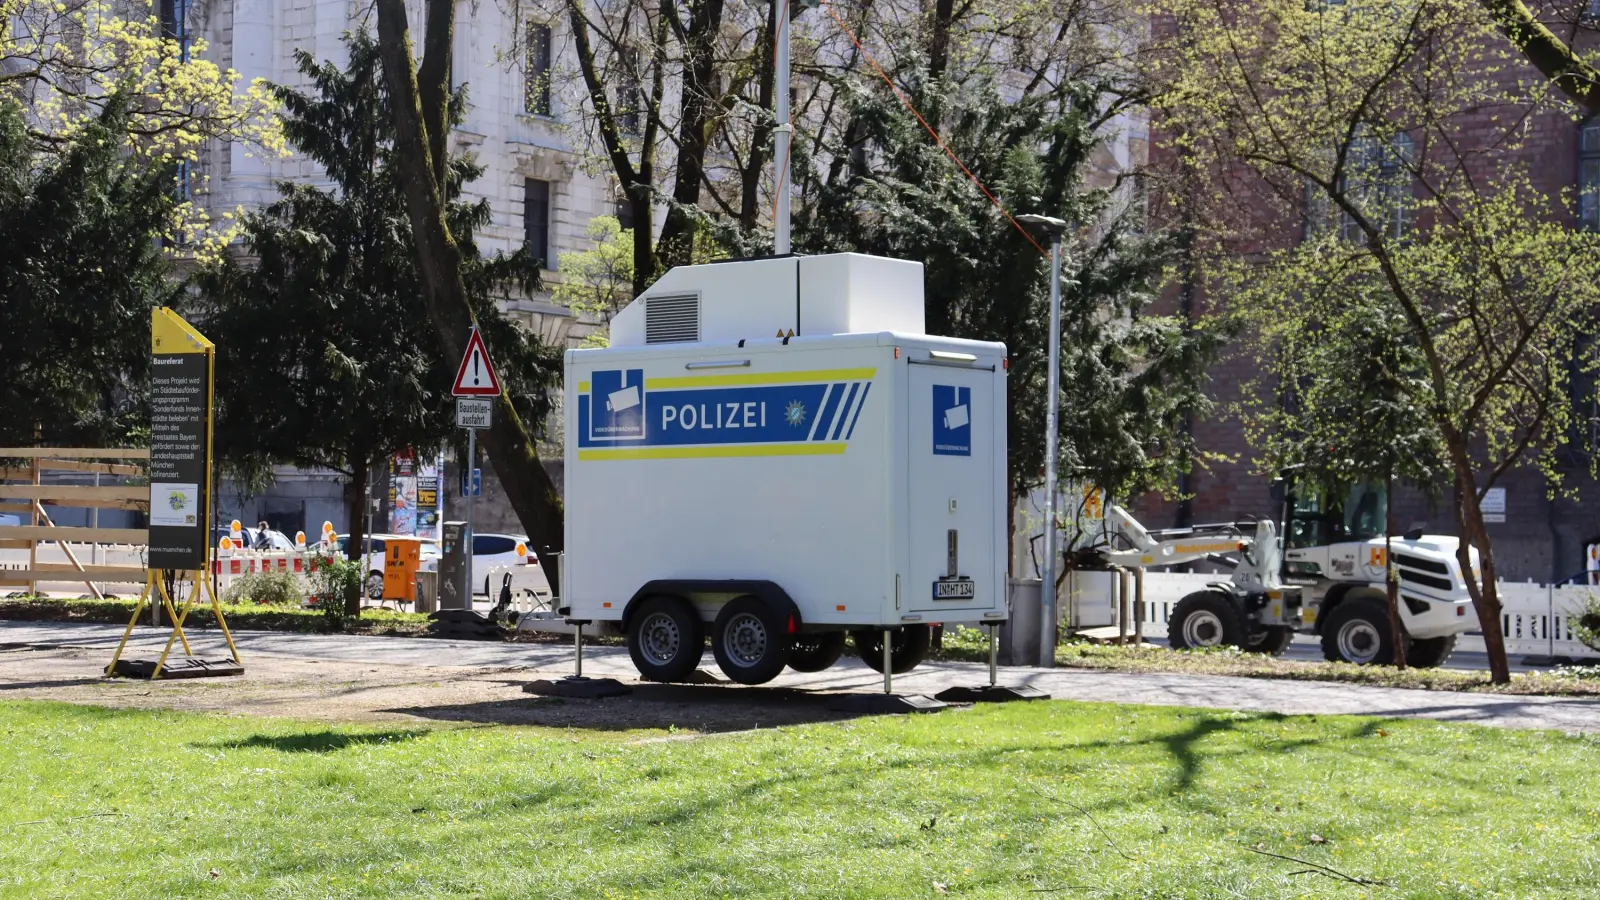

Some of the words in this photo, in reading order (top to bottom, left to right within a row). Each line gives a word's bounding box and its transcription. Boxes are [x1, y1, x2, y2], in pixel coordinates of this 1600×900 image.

[153, 357, 184, 365] Baureferat
[170, 377, 188, 385] Projekt
[460, 401, 490, 414] Baustellen-
[462, 414, 485, 425] ausfahrt
[662, 402, 766, 430] POLIZEI
[180, 434, 196, 442] Bayern
[151, 442, 174, 450] gefördert
[152, 452, 194, 460] Landeshauptstadt
[1370, 548, 1386, 568] H
[1241, 572, 1251, 582] 20
[939, 584, 947, 596] IN
[950, 584, 959, 596] HT
[960, 584, 972, 595] 134
